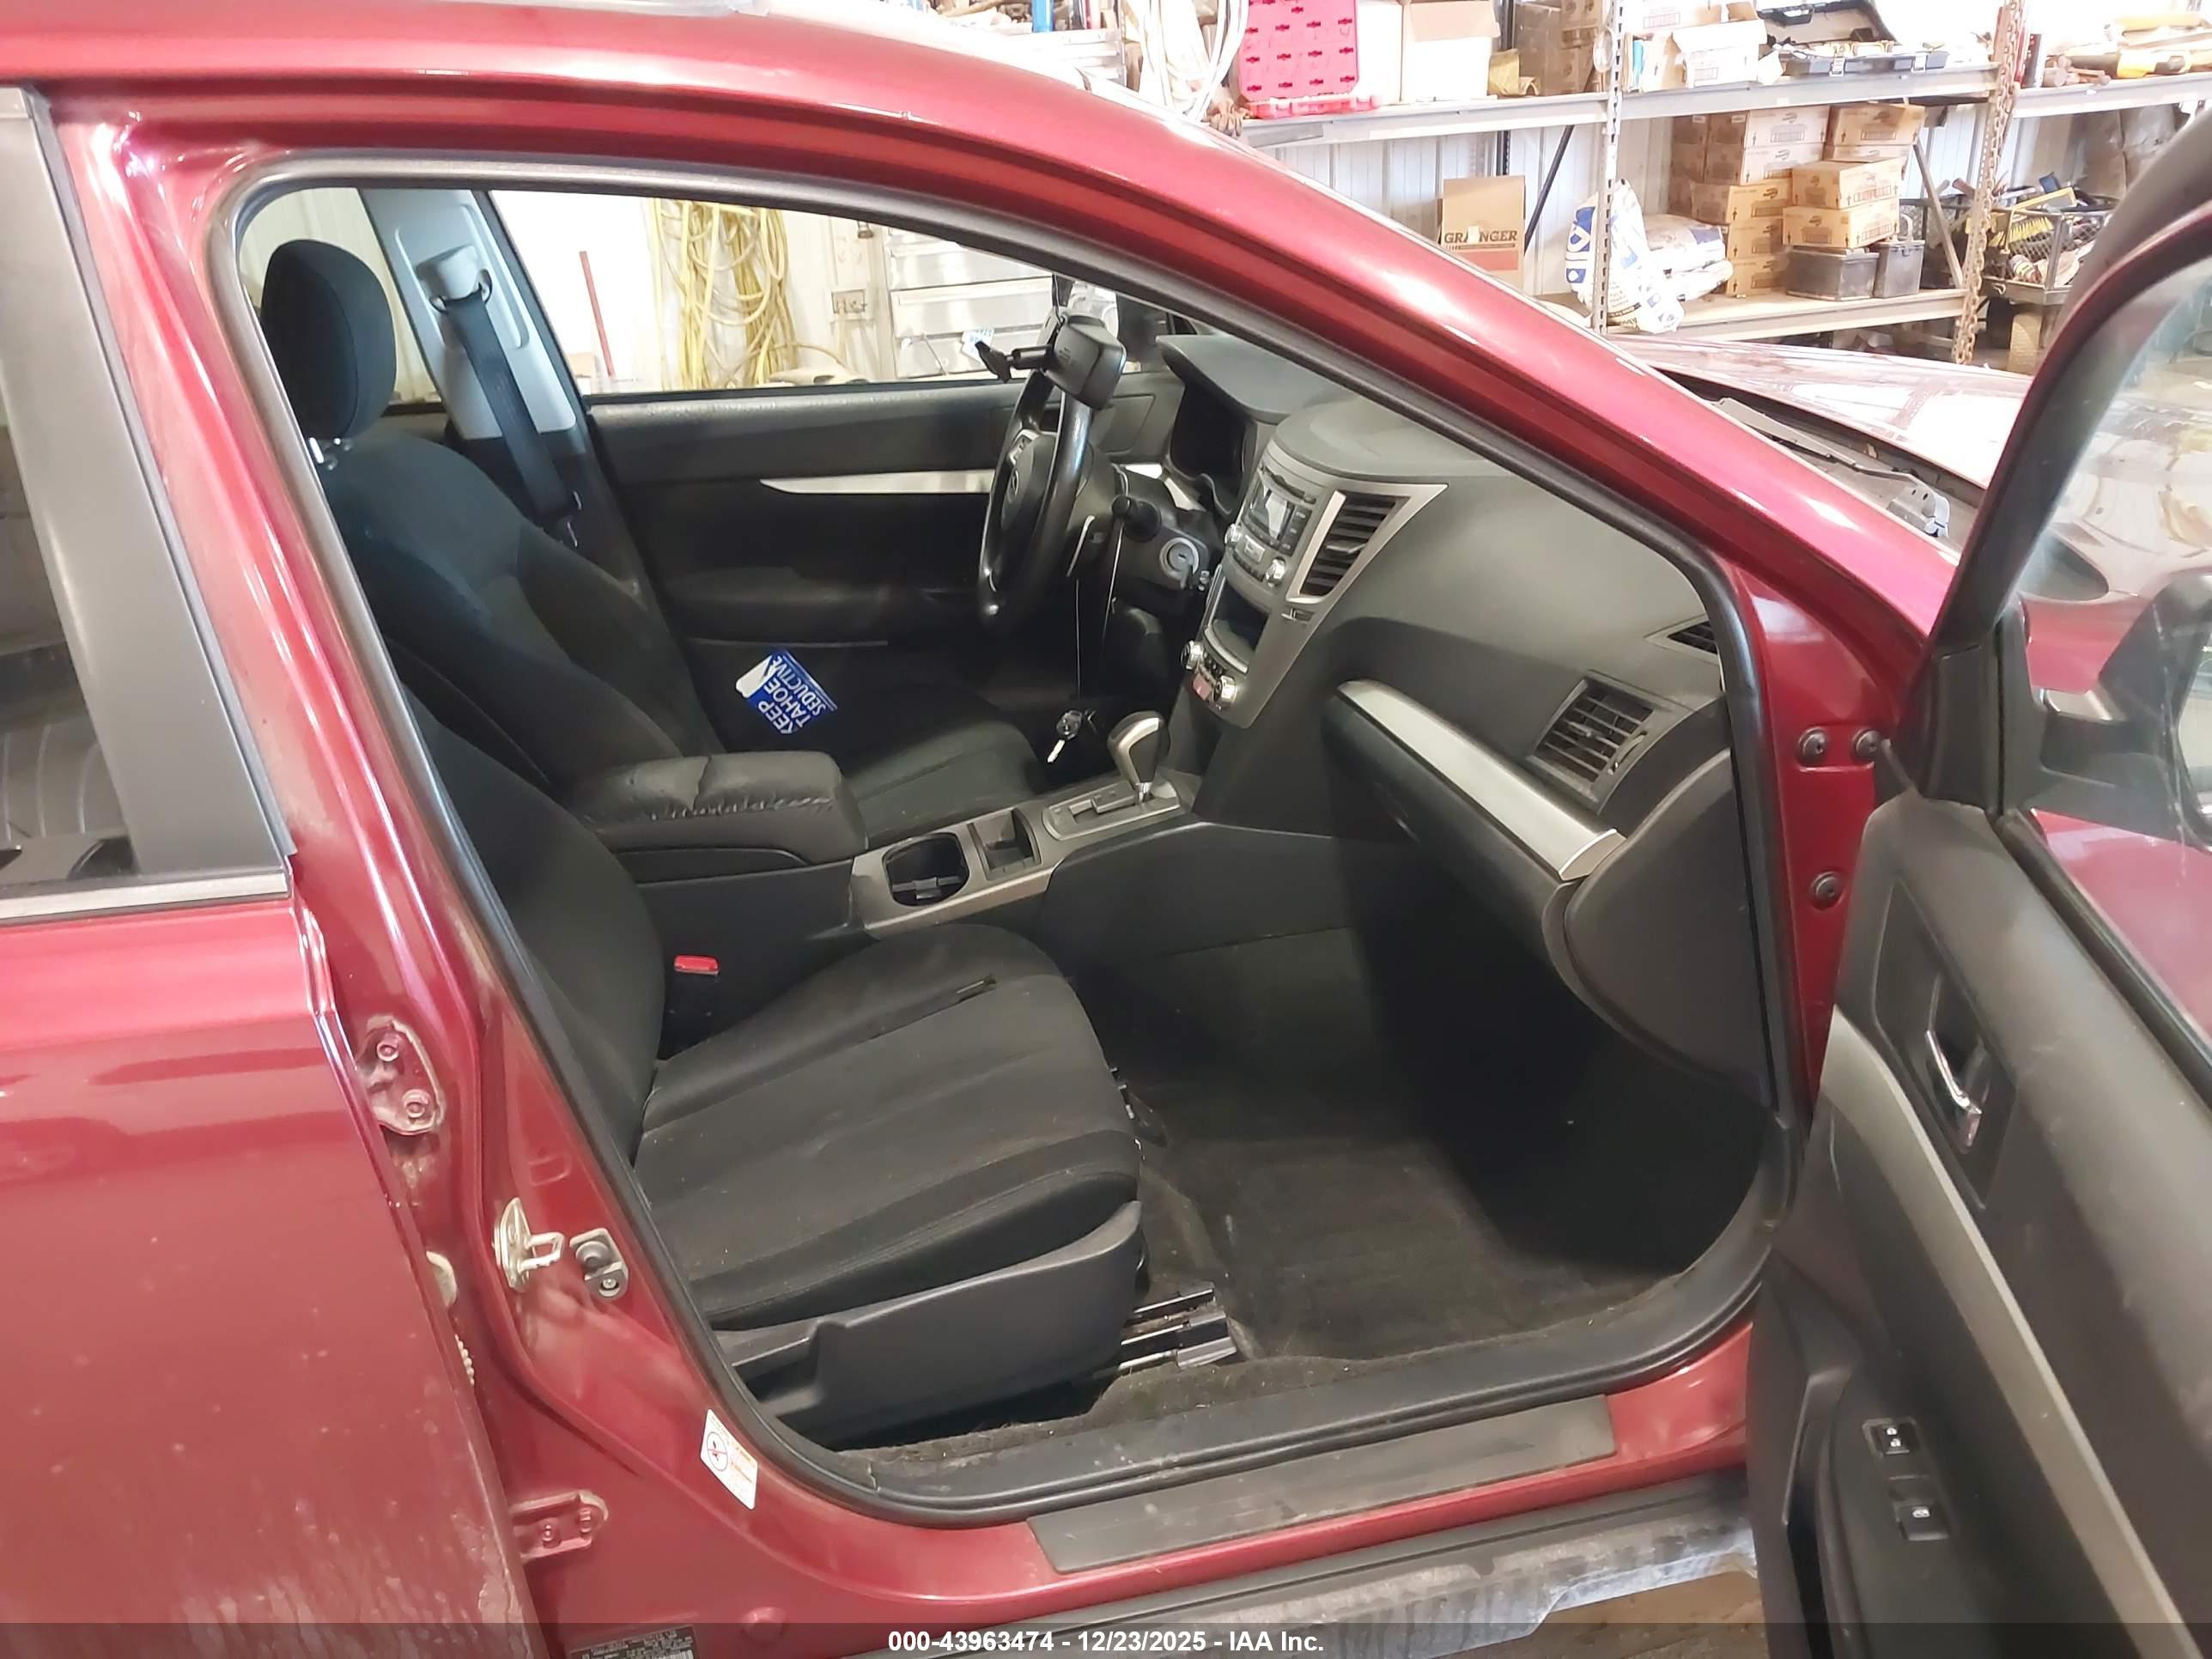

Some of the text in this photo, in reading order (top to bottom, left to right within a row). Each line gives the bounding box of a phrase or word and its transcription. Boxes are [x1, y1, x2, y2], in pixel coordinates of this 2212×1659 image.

[1443, 230, 1517, 244] GRNGER
[763, 677, 811, 728] TAHOE
[773, 655, 826, 716] SEDUCTIVE
[758, 701, 793, 734] KEEP
